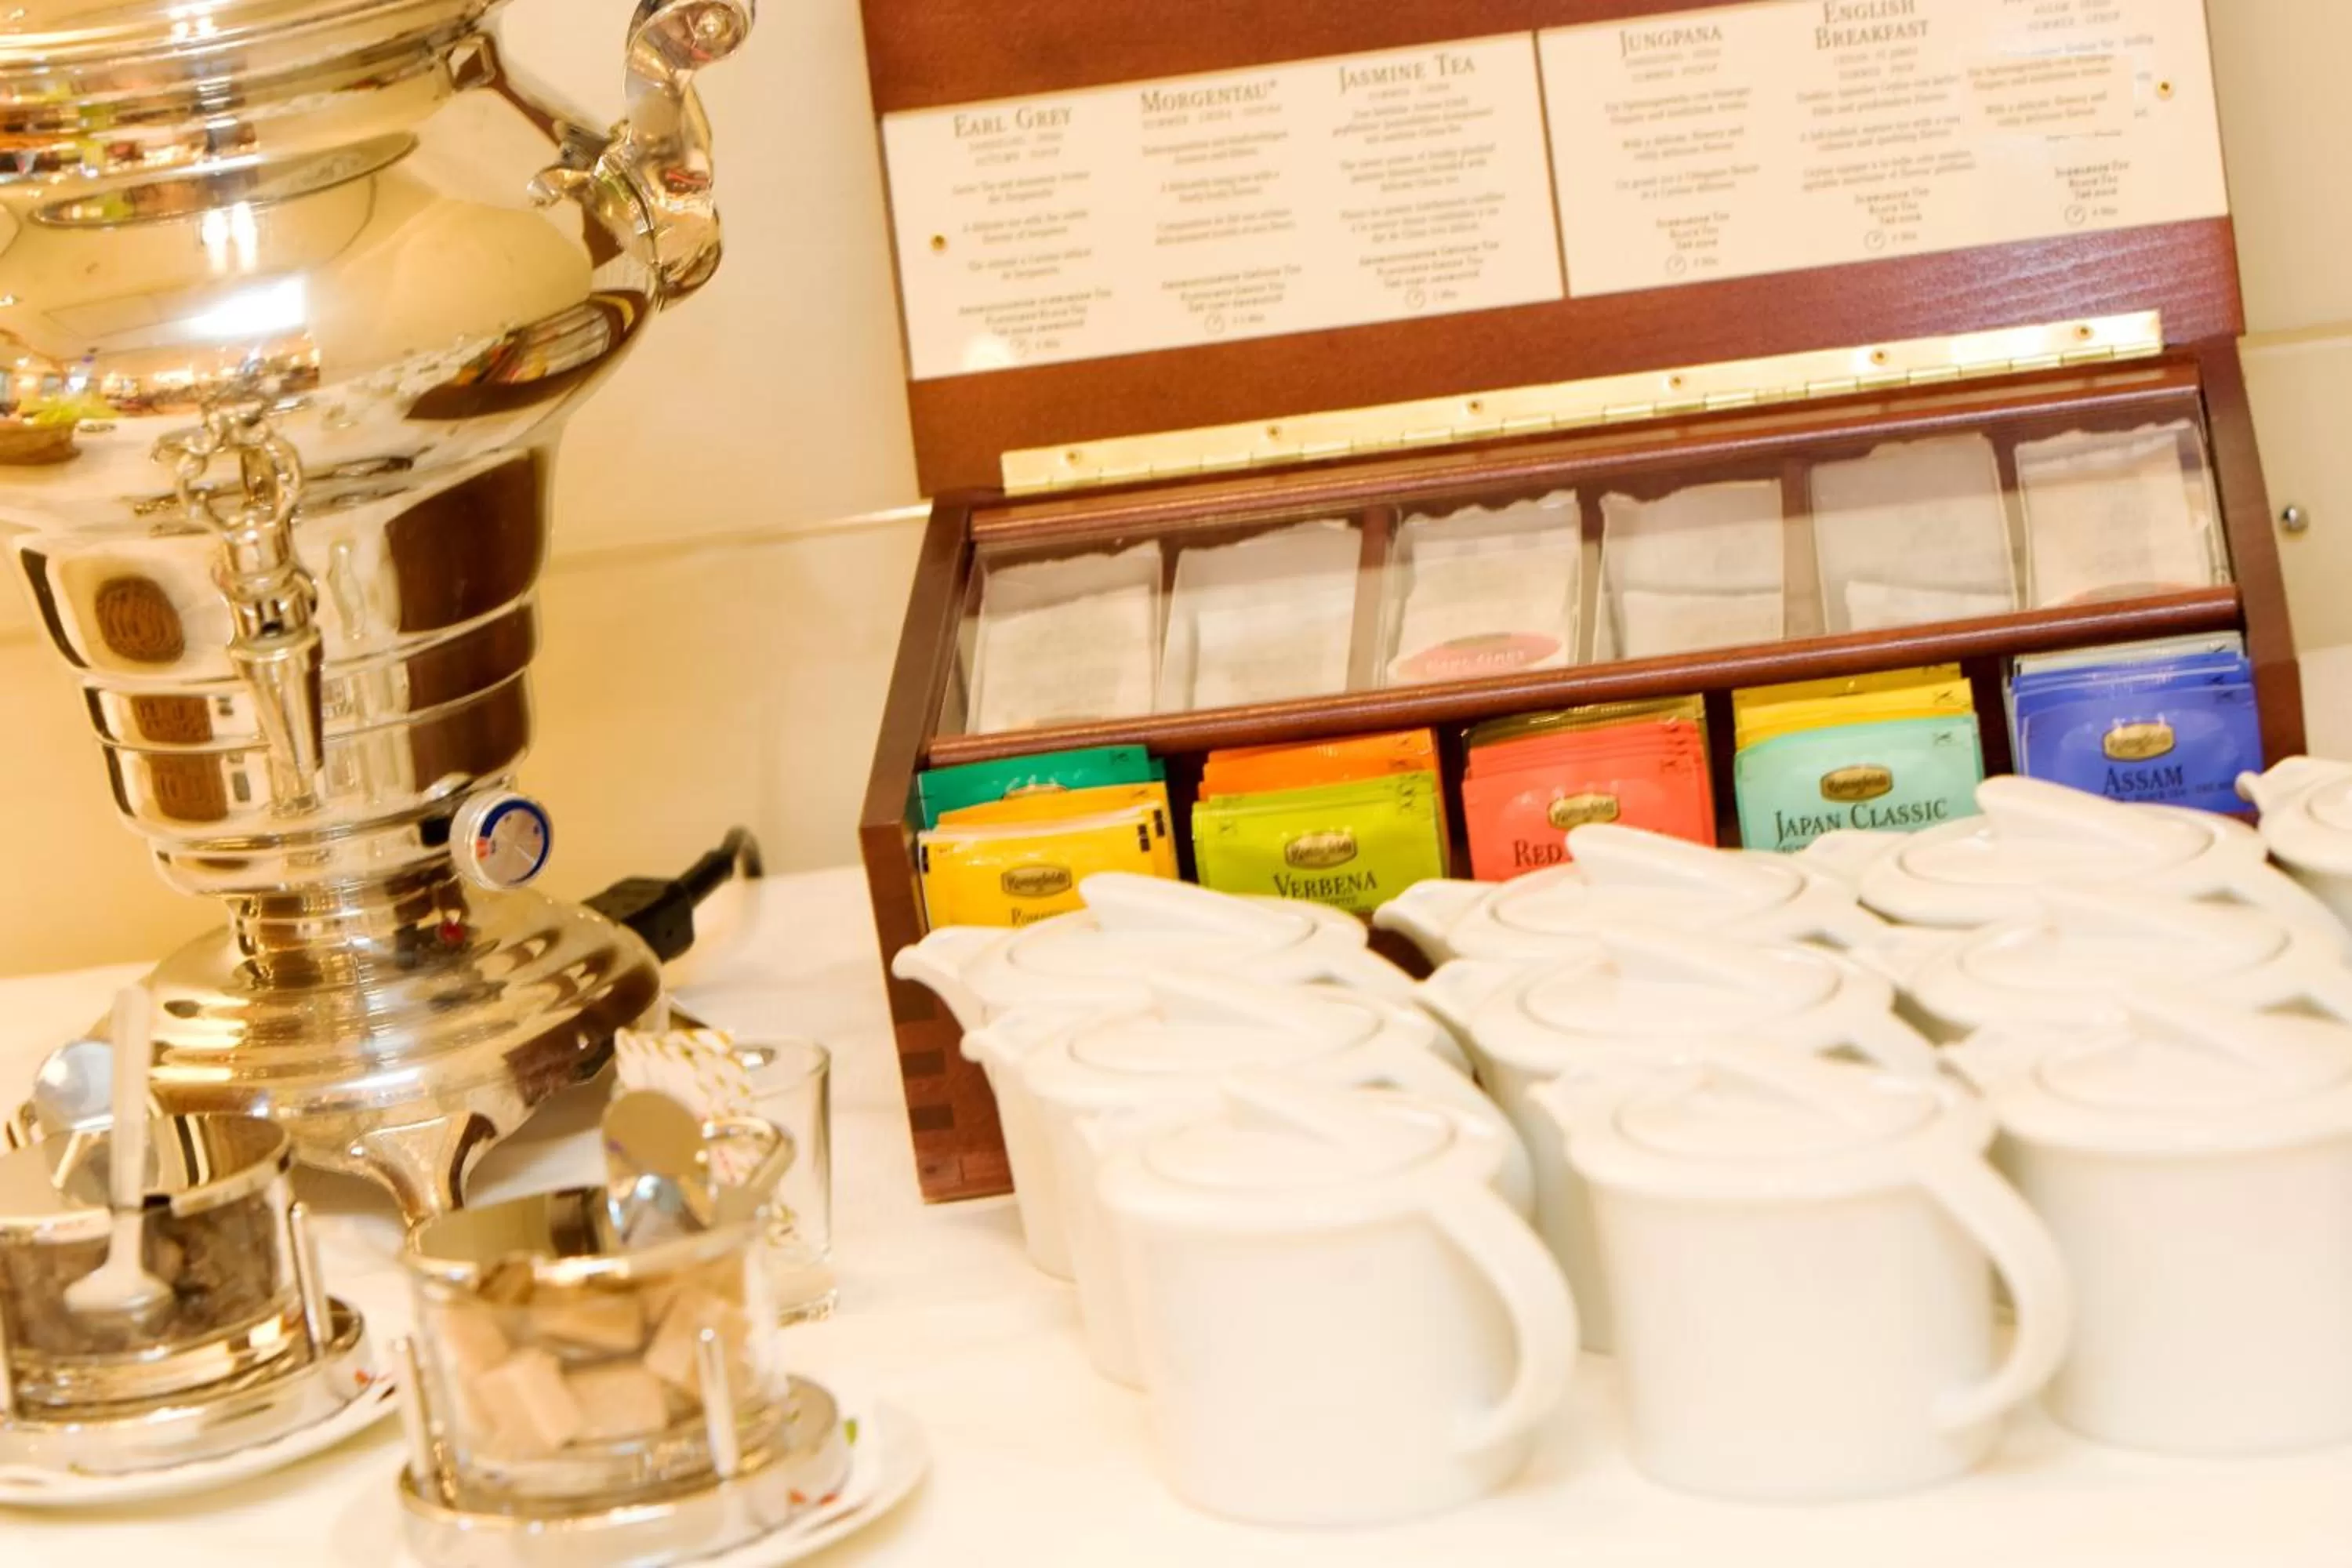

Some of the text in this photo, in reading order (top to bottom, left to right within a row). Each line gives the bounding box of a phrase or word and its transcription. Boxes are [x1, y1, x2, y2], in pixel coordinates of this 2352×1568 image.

[1822, 0, 1916, 24] ENGLISH
[1619, 25, 1723, 58] JUNGPANA
[1815, 20, 1929, 51] BREAKFAST
[1338, 61, 1427, 95] JASMINE
[1434, 53, 1476, 77] TEA
[953, 105, 1073, 139] EARL GREY
[2103, 763, 2183, 795] ASSAM
[1774, 797, 1948, 844] JAPAN CLASSIC
[1513, 839, 1563, 867] RED
[1272, 870, 1377, 898] VERBENA
